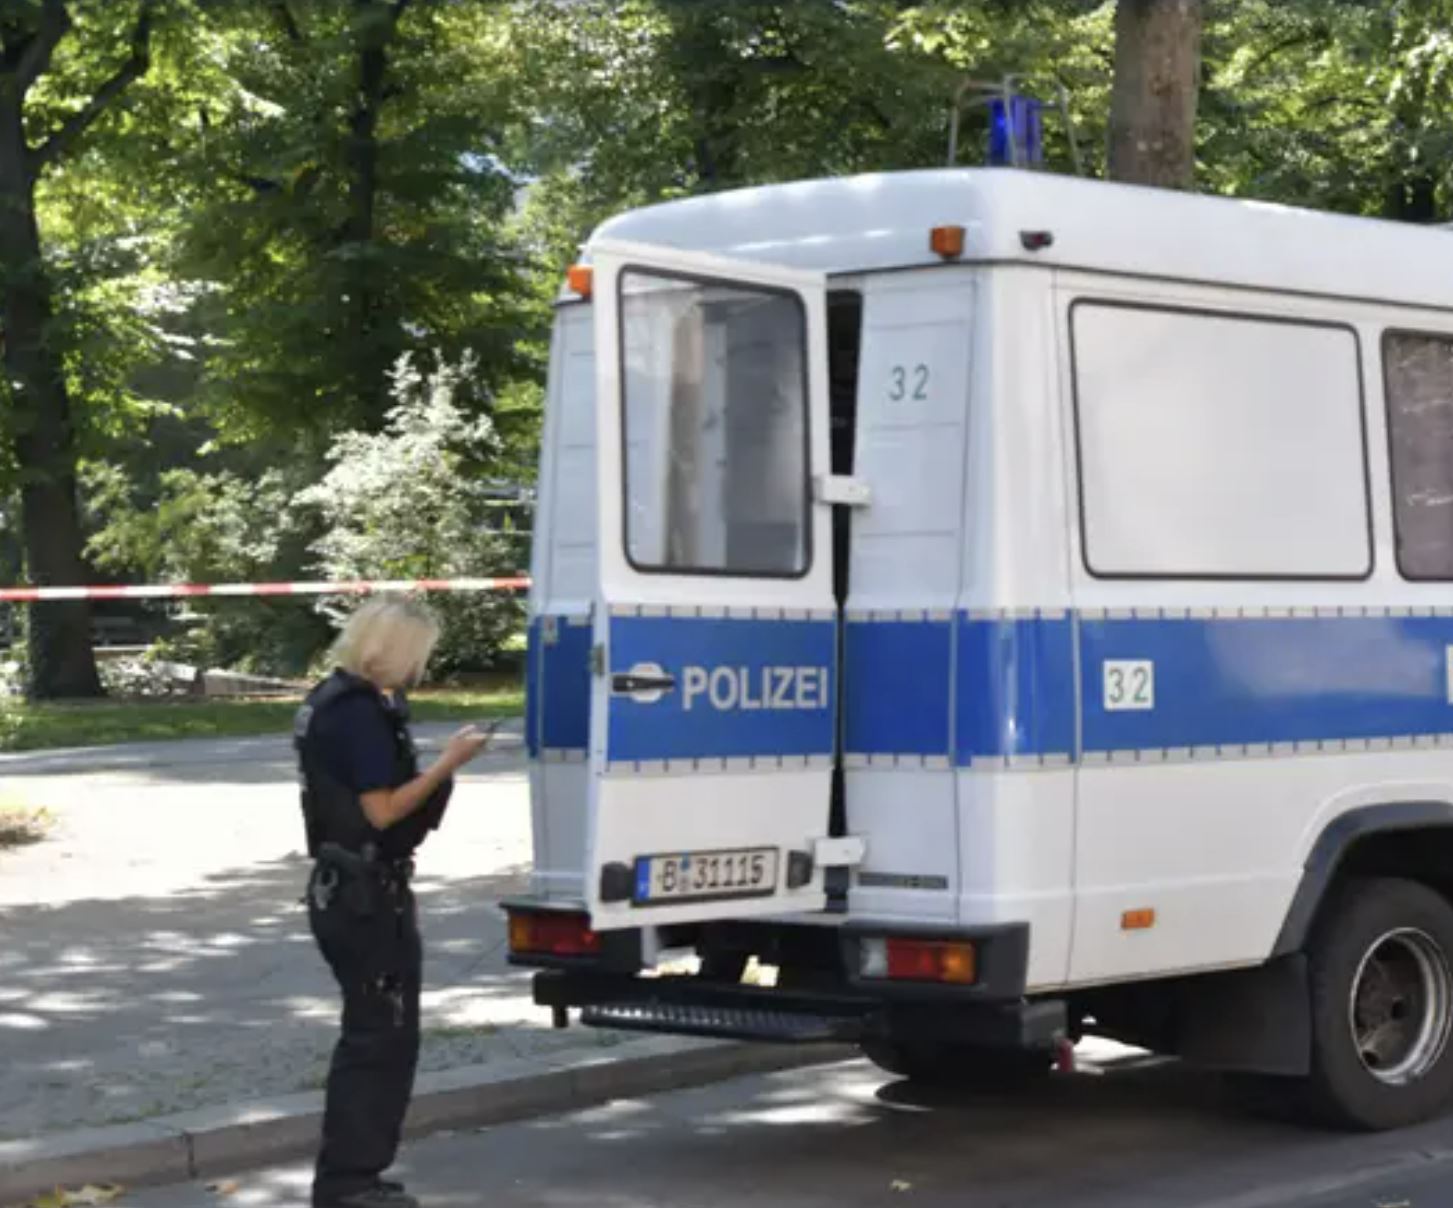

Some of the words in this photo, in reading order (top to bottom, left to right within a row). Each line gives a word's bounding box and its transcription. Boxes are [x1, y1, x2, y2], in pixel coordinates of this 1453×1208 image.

[888, 364, 930, 401] 32
[681, 665, 829, 711] POLIZEI
[1107, 666, 1150, 703] 32
